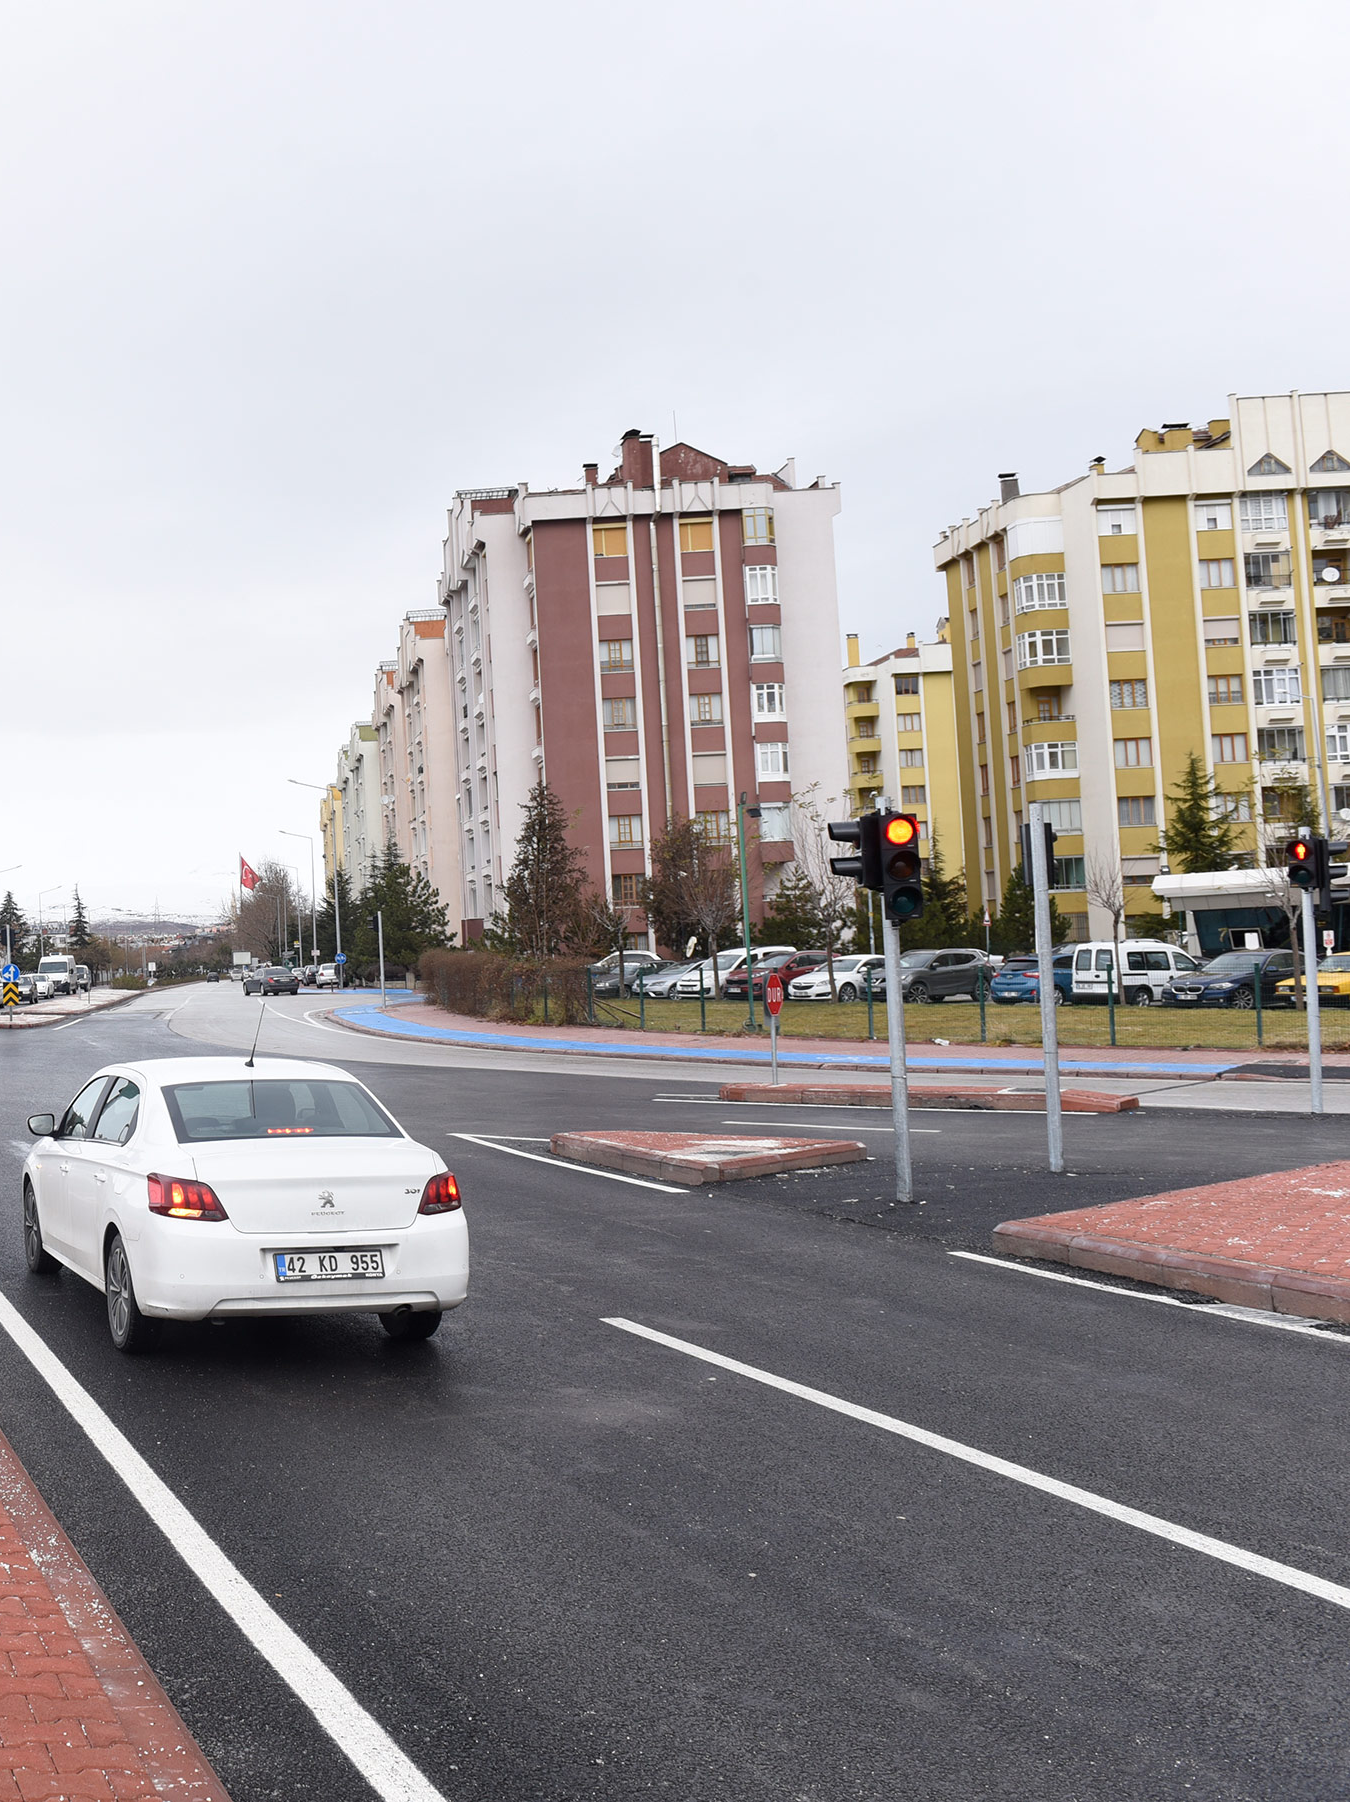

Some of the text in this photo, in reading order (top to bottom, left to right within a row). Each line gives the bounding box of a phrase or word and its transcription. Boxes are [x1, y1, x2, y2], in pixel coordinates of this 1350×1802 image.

[767, 987, 782, 1003] DUR
[287, 1253, 380, 1273] 42 KD 955
